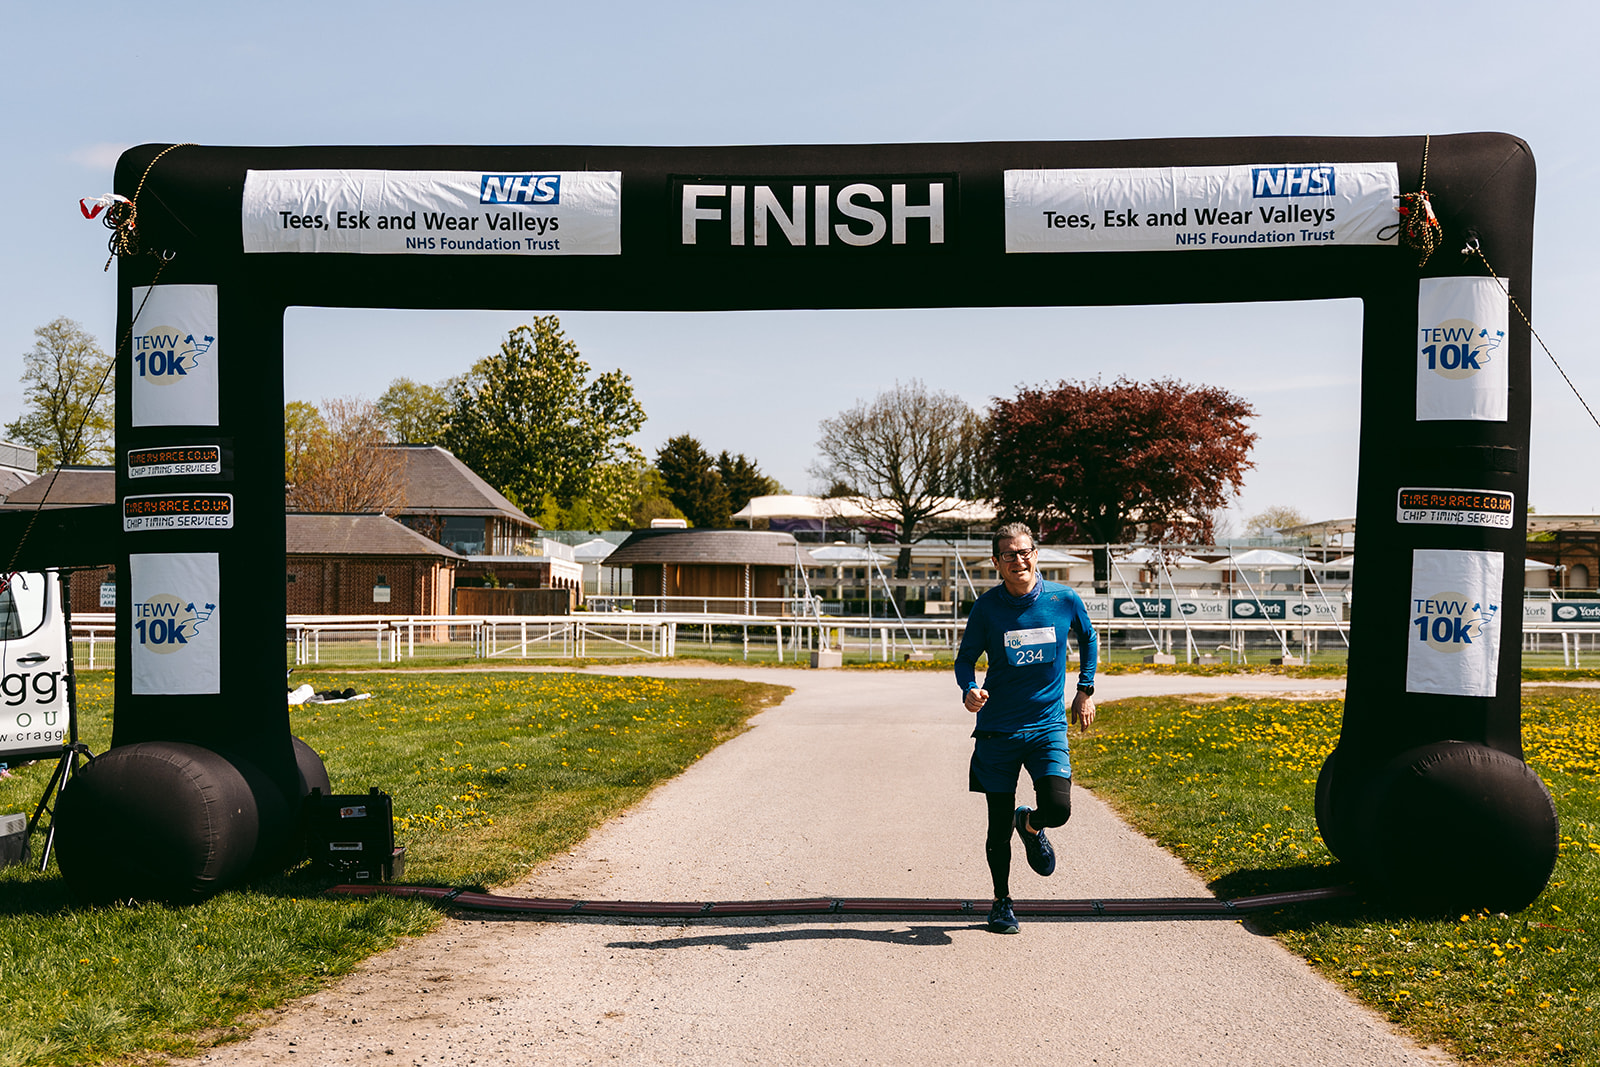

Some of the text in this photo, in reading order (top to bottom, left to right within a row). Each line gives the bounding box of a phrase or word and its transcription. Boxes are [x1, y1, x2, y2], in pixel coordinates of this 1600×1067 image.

[482, 176, 558, 203] NHS
[1255, 167, 1332, 196] NHS
[279, 210, 559, 236] Tees, Esk and Wear Valleys
[682, 183, 945, 247] FINISH
[1043, 204, 1336, 230] Tees, Esk and Wear Valleys
[406, 237, 560, 251] NHS Foundation Trust
[1175, 229, 1335, 246] NHS Foundation Trust
[134, 334, 179, 350] TEWV
[1421, 327, 1474, 343] TEWV
[134, 350, 188, 377] 10k
[1421, 344, 1482, 370] 10k
[131, 464, 217, 477] CHIP TIMING SERVICES
[127, 516, 229, 529] CHIP TIMING SERVICES
[1403, 510, 1510, 526] CHIP TIMING SERVICES
[134, 602, 180, 617] TEWV
[1085, 601, 1108, 611] York
[1143, 601, 1167, 612] York
[1201, 603, 1223, 613] York
[1258, 603, 1281, 614] York
[1315, 604, 1337, 614] York
[1414, 600, 1468, 616] TEWV
[1524, 606, 1546, 616] York
[134, 619, 188, 645] 10k
[1413, 616, 1473, 644] 10k
[1007, 638, 1022, 647] 10k
[1016, 649, 1044, 665] 234
[0, 671, 61, 706] gg
